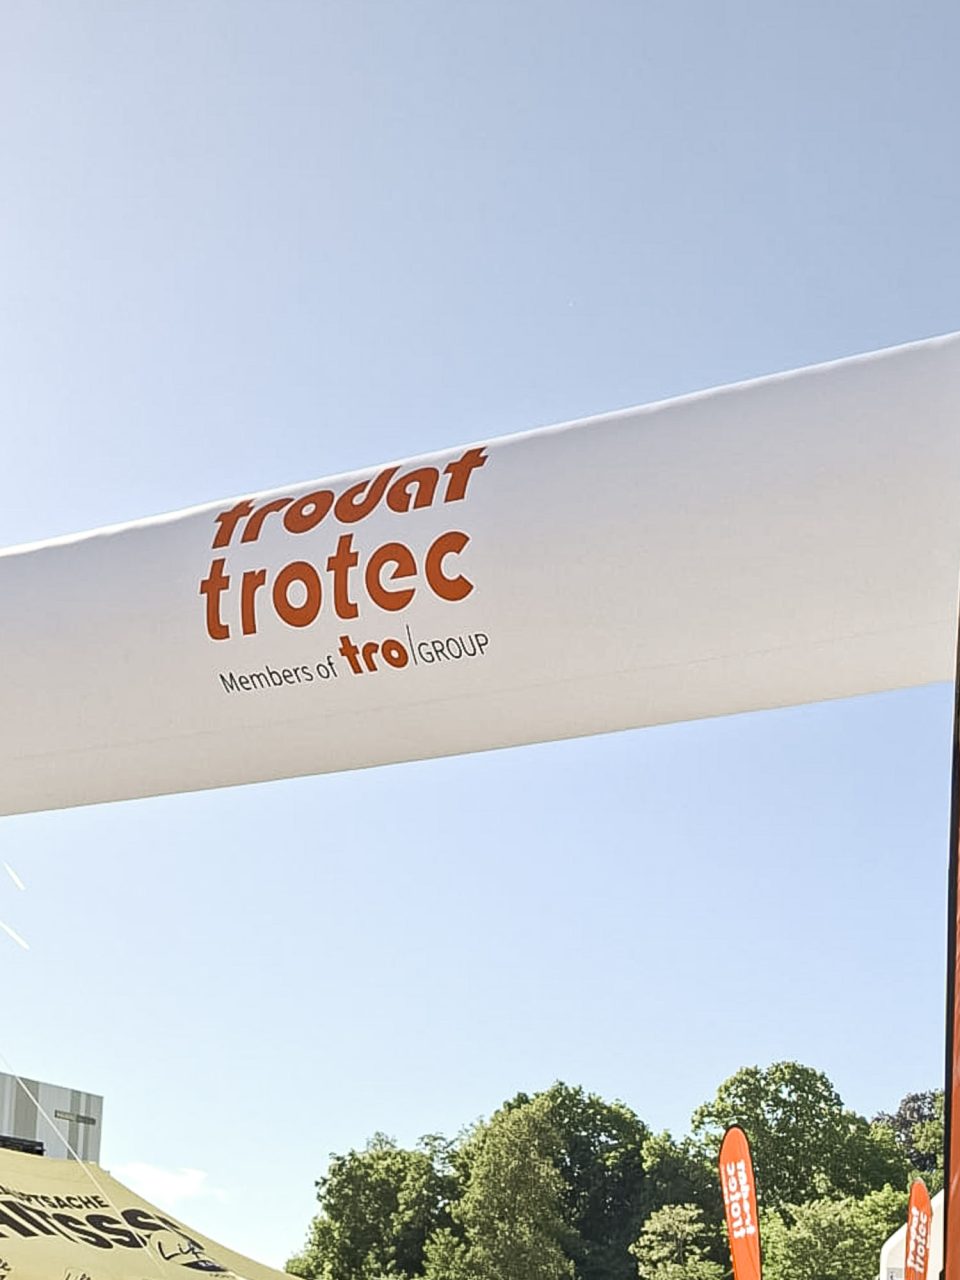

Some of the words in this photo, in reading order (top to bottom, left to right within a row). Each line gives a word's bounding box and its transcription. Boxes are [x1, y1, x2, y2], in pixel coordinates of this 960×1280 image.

[211, 446, 489, 549] trodat
[200, 531, 474, 641] trotec
[219, 665, 313, 694] Members
[316, 656, 338, 678] of
